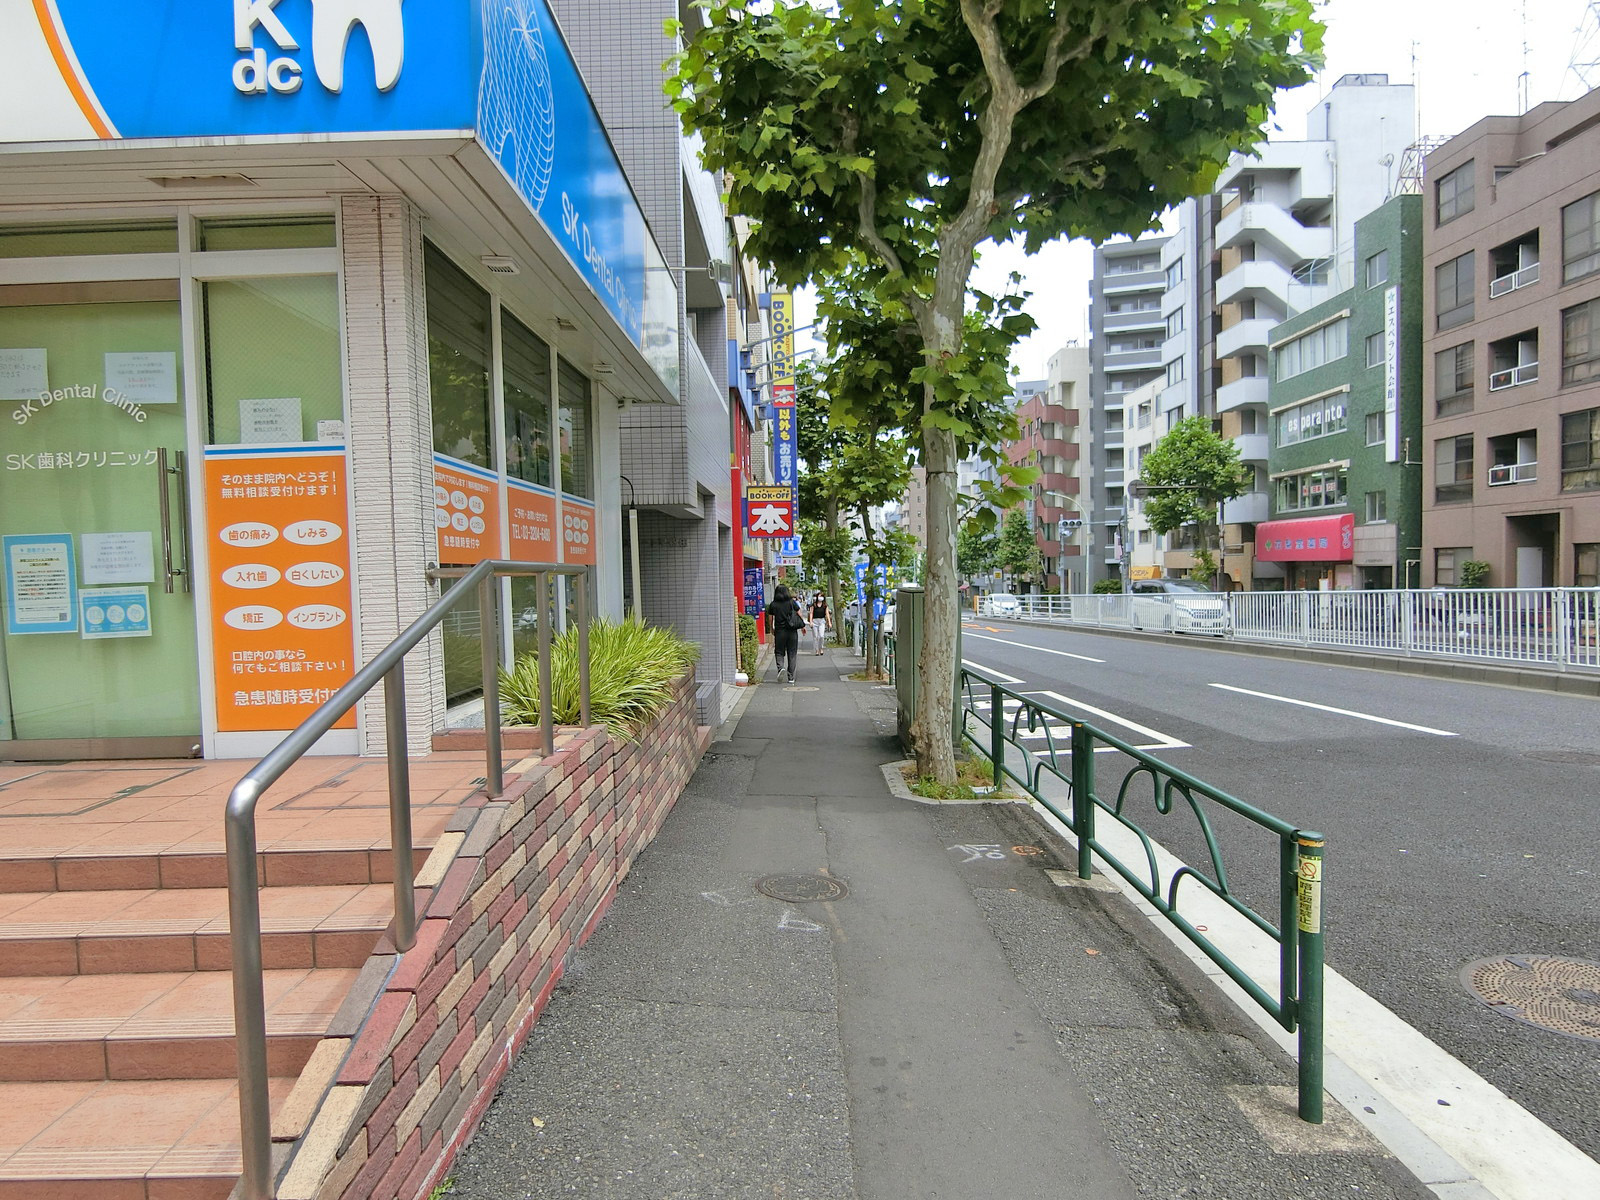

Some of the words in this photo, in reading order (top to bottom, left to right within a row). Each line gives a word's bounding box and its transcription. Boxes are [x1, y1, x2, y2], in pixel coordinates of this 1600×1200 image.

[232, 48, 303, 94] dc
[561, 191, 581, 250] SK
[582, 222, 615, 298] Dental
[1387, 305, 1396, 400] エスペラント会館
[12, 399, 40, 426] SK
[39, 383, 98, 408] Dental
[102, 387, 148, 423] Clinic
[5, 450, 158, 471] SK歯科クリニック
[221, 484, 337, 499] 無料相談受付けます！
[751, 503, 790, 534] 本
[228, 529, 271, 541] 歯の痛み
[297, 528, 328, 539] しみる
[235, 570, 268, 582] 入れ歯
[291, 569, 340, 581] 白くしたい
[242, 612, 264, 624] 矯正
[293, 611, 341, 623] インプラント
[231, 649, 307, 662] 口腔内の事なら
